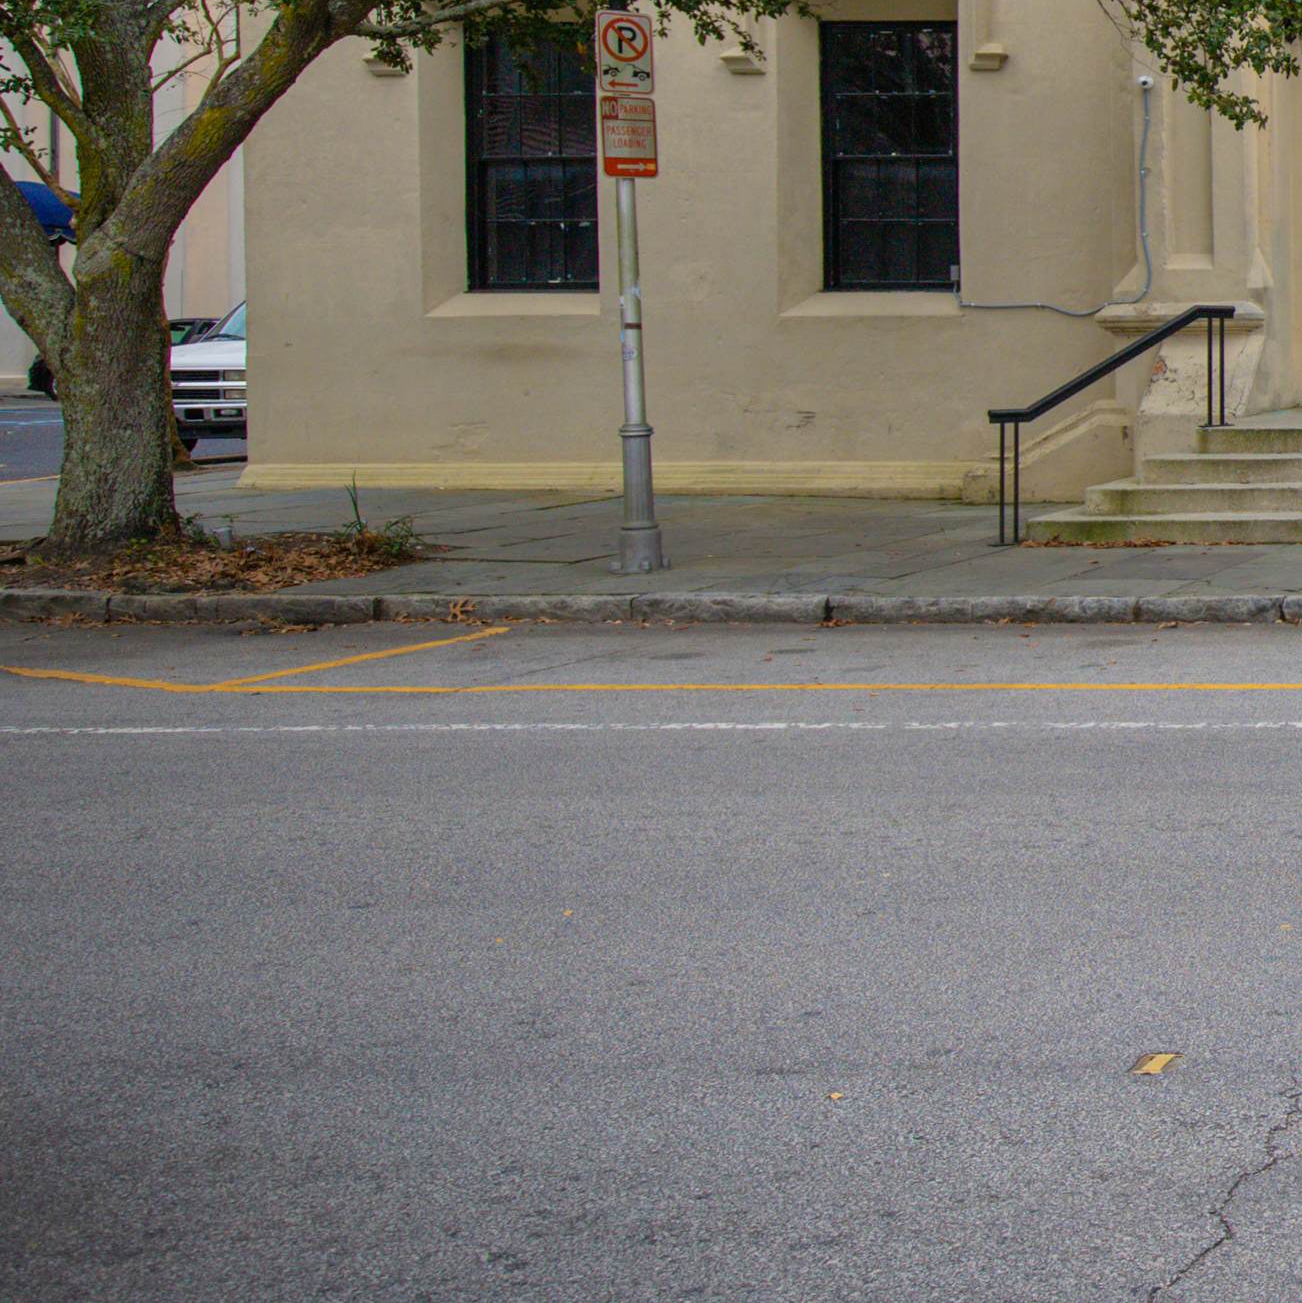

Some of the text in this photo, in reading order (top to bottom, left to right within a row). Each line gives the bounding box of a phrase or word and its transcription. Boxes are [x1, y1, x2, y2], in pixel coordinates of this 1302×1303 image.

[602, 100, 653, 116] NO PARKING
[607, 124, 652, 137] PASSENGER
[614, 137, 647, 150] LOADING
